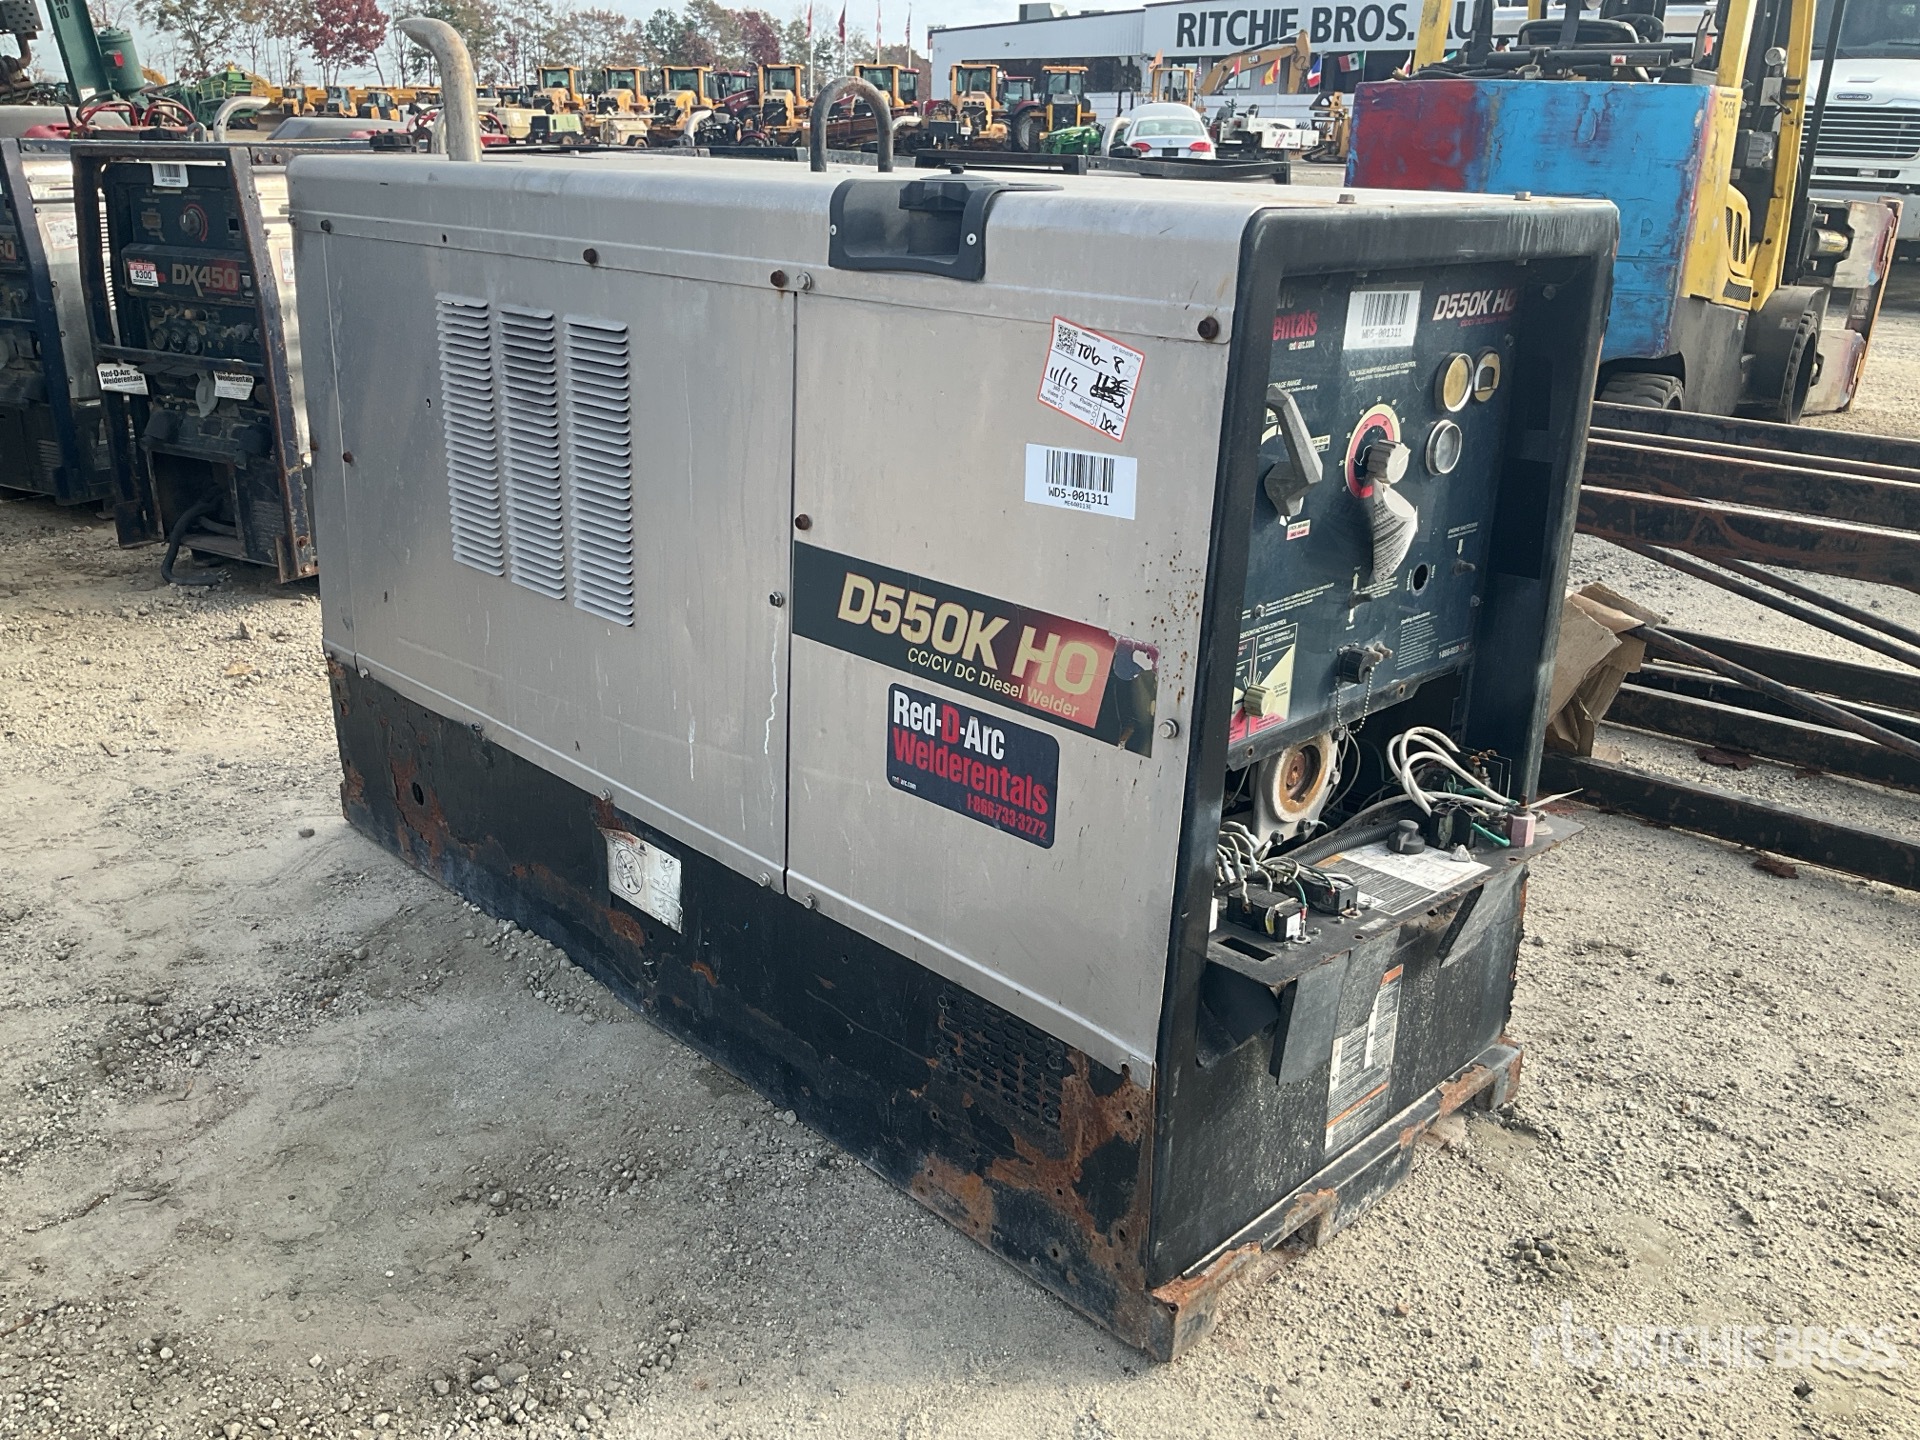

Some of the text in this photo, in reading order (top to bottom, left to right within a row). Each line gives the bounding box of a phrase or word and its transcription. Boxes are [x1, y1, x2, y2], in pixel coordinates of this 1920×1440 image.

[57, 6, 70, 19] 10
[1176, 8, 1299, 48] RITCHIE
[1310, 4, 1415, 43] BROS.
[1248, 55, 1259, 63] CAT
[135, 270, 152, 280] $300
[172, 263, 237, 297] DX450
[1432, 288, 1518, 321] D550K HO
[1361, 328, 1402, 339] WD5-001311
[101, 369, 131, 378] Red-D-Arc
[102, 375, 143, 385] Welderentals
[1048, 486, 1110, 506] WD5-001311
[837, 571, 1099, 696] D550K HO
[907, 647, 1080, 718] CC/CV DC Diesel Welder
[893, 690, 1005, 760] Red-D-Arc
[892, 726, 1049, 815] Welderentals
[966, 792, 1047, 840] 1-866-733-3272
